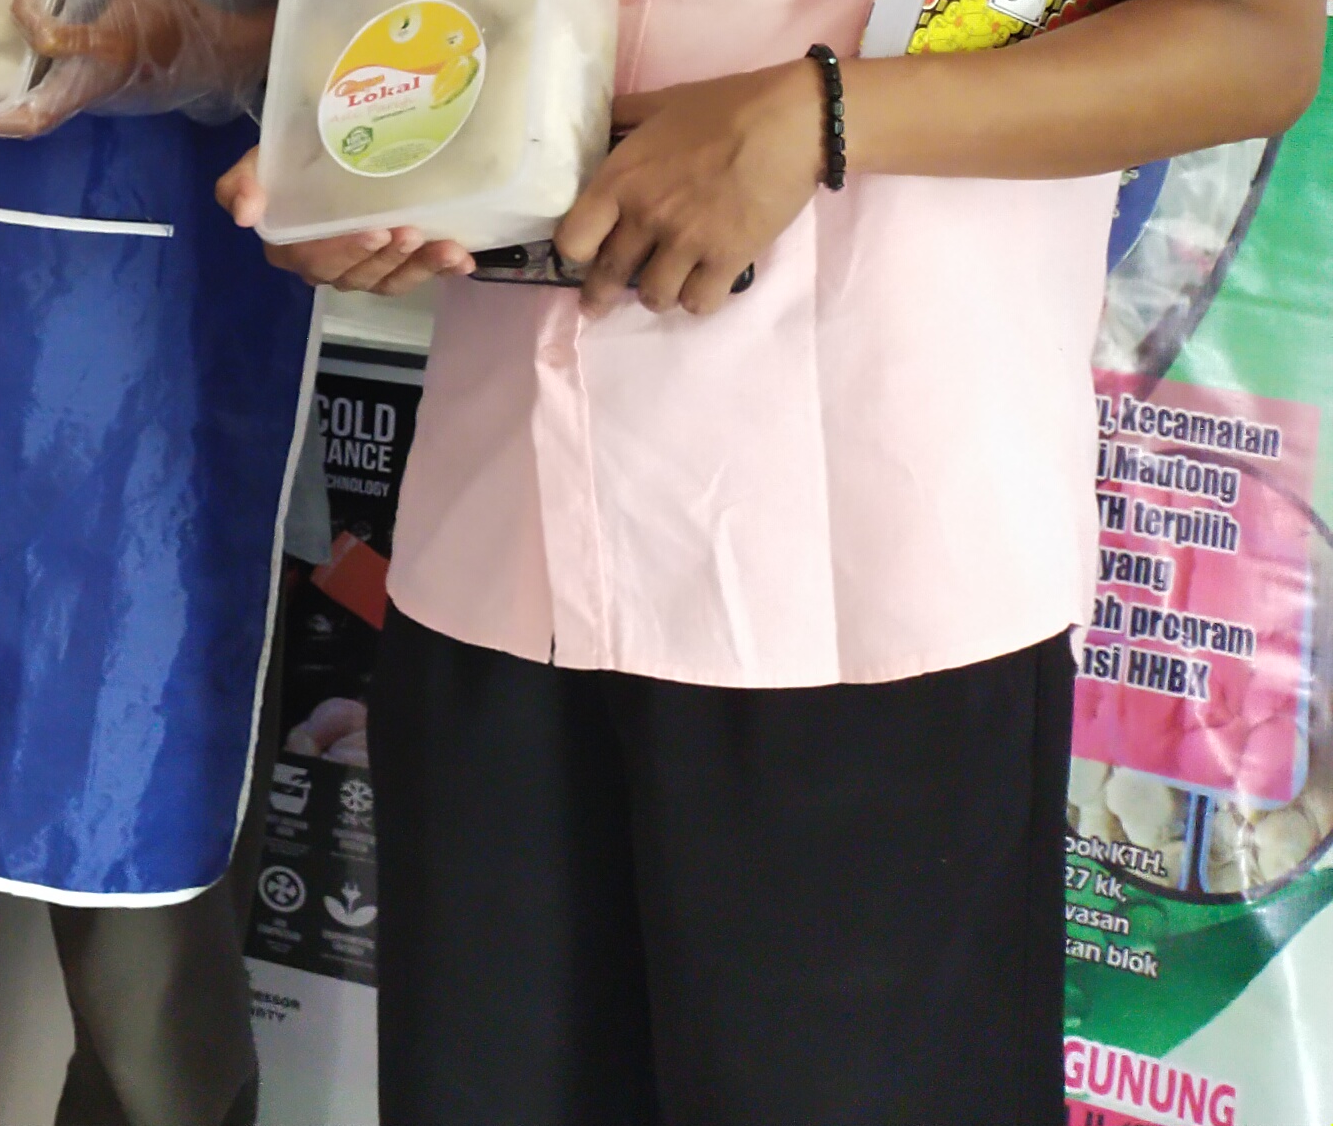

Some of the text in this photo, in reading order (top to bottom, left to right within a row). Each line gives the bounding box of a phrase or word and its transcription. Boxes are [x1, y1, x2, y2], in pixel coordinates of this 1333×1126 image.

[347, 76, 420, 107] Lokal
[1121, 396, 1280, 458] kecamatan
[1113, 445, 1238, 504] Mautong
[1133, 501, 1238, 551] terpilih
[1099, 549, 1173, 592] yang
[1106, 943, 1159, 978] blok
